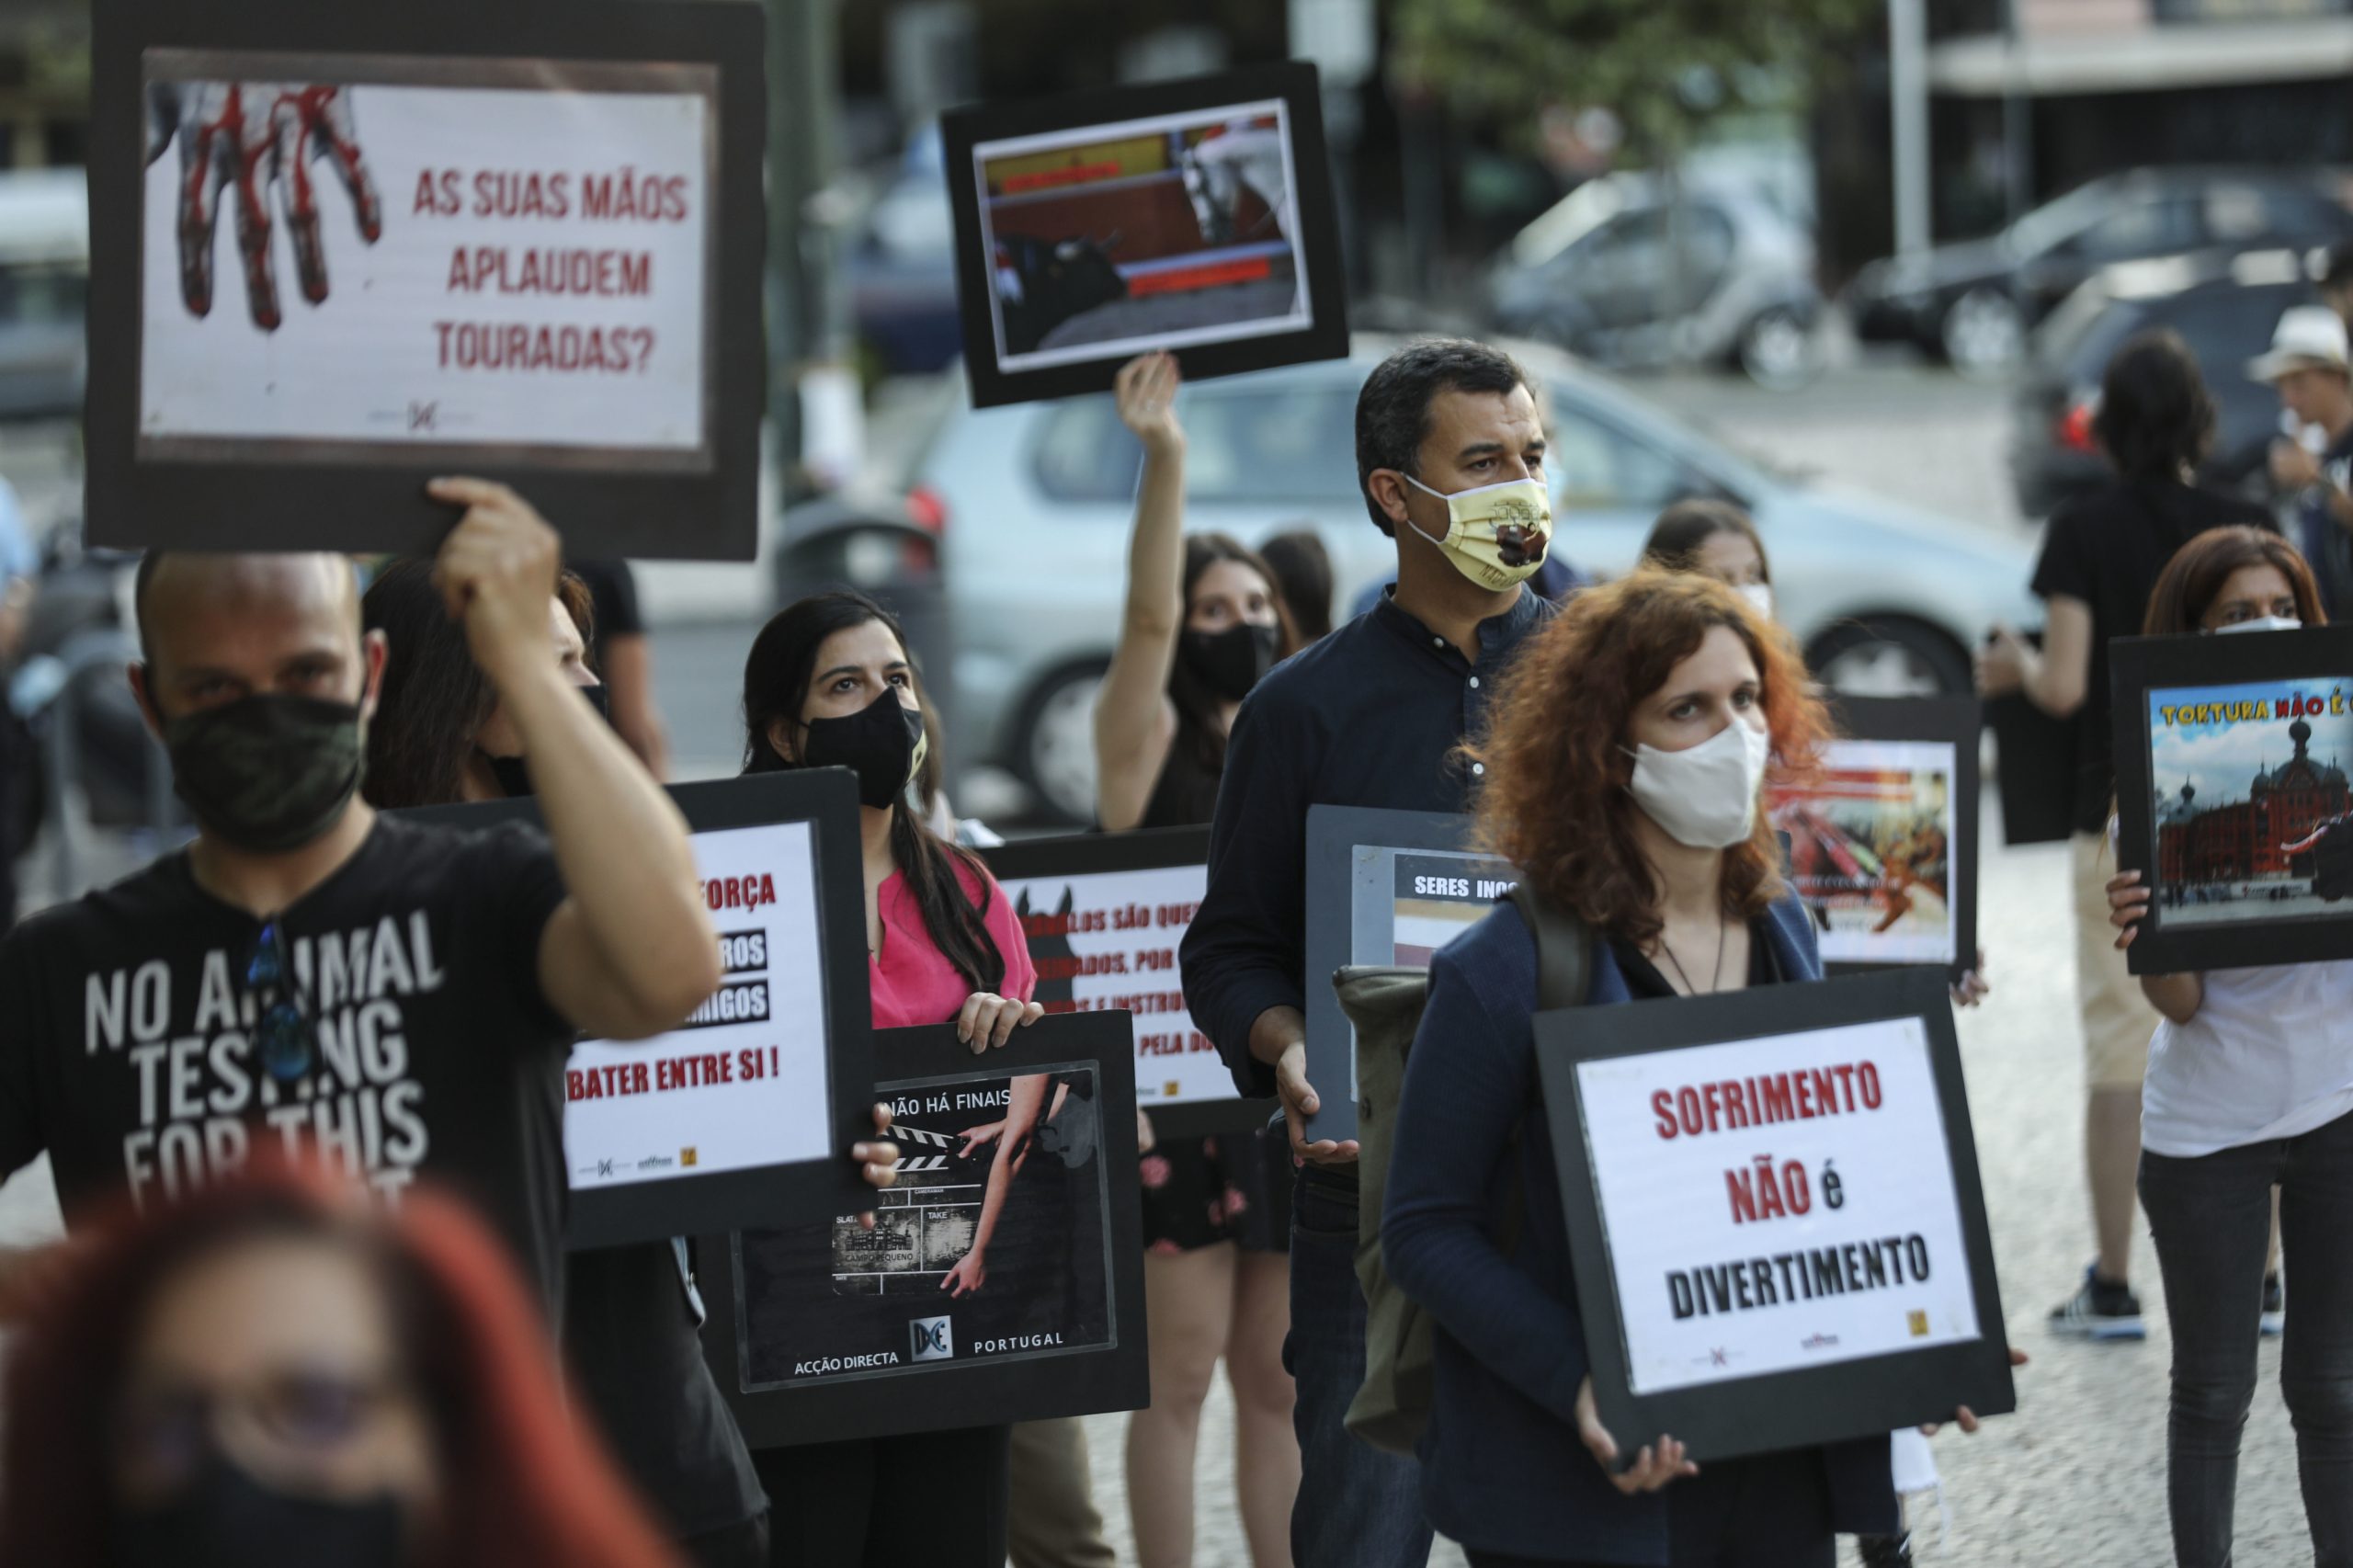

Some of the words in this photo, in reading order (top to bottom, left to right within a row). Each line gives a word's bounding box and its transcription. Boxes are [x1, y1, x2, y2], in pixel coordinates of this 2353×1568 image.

[413, 168, 461, 218] AS
[472, 170, 568, 220] SUAS
[581, 165, 688, 223] MÃOS
[448, 245, 650, 297] APLAUDEM
[434, 322, 655, 374] TOURADAS?
[2160, 699, 2268, 727] TORTURA
[2275, 691, 2324, 719] NÃO
[1415, 875, 1469, 897] SERES
[1113, 903, 1151, 930] SÃO
[1135, 949, 1173, 971] POR
[85, 960, 171, 1055] NO
[1111, 991, 1188, 1015] INSTRU
[130, 999, 408, 1125] TESNG
[1141, 1032, 1183, 1057] PELA
[656, 1053, 733, 1091] ENTRE
[926, 1092, 949, 1113] HÁ
[956, 1090, 1011, 1110] FINAIS
[1652, 1060, 1882, 1140] SOFRIMENTO
[267, 1081, 427, 1178] THIS
[1725, 1154, 1810, 1224] NÃO
[1821, 1160, 1844, 1210] é
[927, 1211, 948, 1220] TAKE
[846, 1254, 875, 1262] CAMPO
[876, 1253, 913, 1262] PEQUENO
[1665, 1233, 1929, 1320] DIVERTIMENTO
[974, 1332, 1063, 1353] PORTUGAL
[795, 1357, 841, 1376] ACÇÃO
[843, 1351, 899, 1369] DIRECTA
